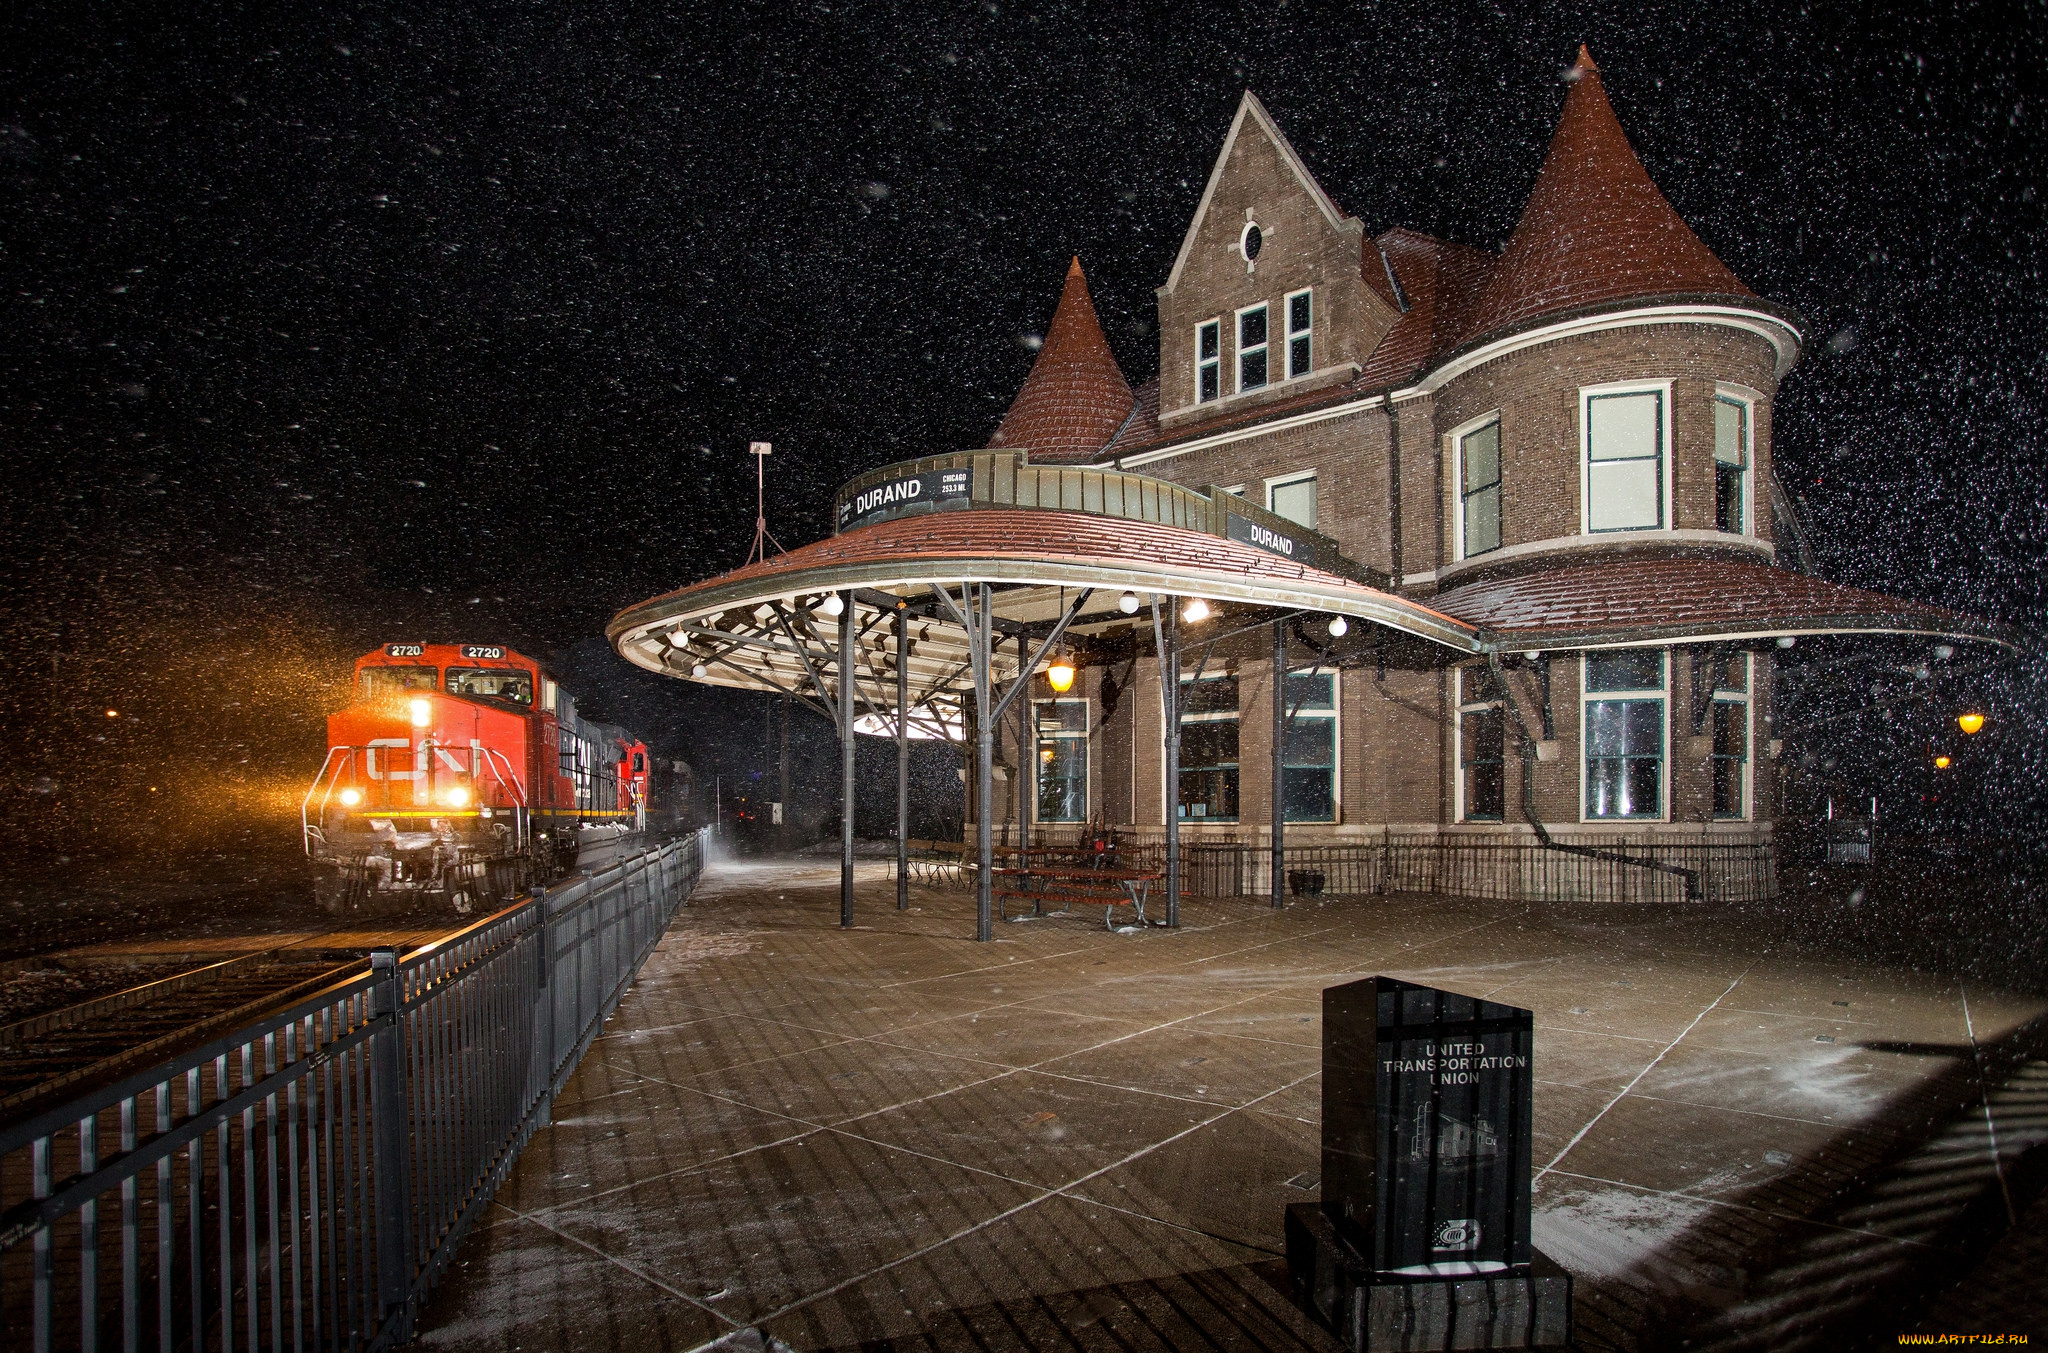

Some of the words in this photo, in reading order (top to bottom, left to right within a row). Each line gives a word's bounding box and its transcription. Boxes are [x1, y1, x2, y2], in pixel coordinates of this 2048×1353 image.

[942, 474, 966, 483] CHICAGO
[941, 484, 957, 493] 253.3
[856, 479, 921, 515] DURAND
[1251, 524, 1293, 555] DURAND
[391, 645, 421, 656] 2720
[468, 646, 500, 658] 2720
[366, 738, 481, 780] CN
[1426, 1043, 1485, 1057] UNITED
[1383, 1056, 1526, 1073] TRANSPORTATION
[1430, 1071, 1480, 1086] UNION
